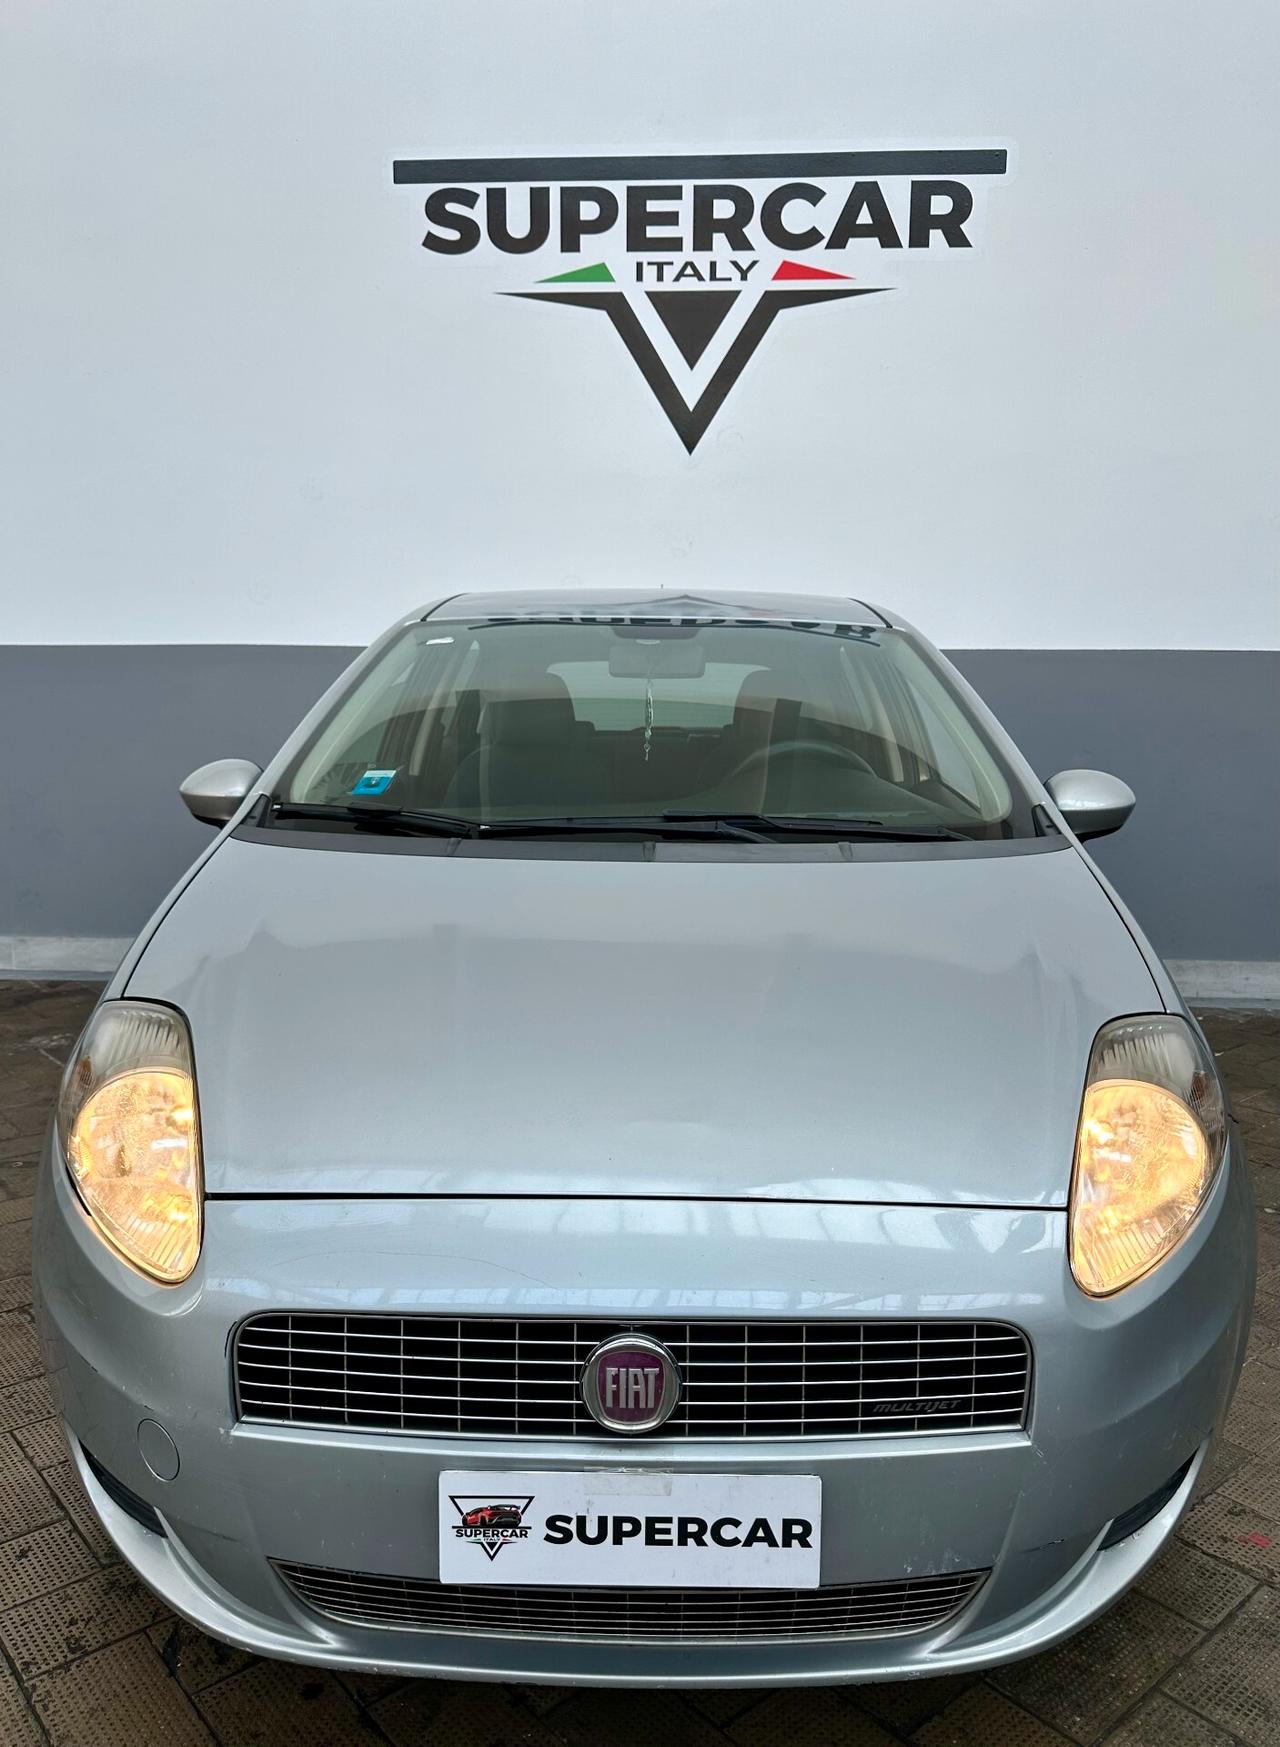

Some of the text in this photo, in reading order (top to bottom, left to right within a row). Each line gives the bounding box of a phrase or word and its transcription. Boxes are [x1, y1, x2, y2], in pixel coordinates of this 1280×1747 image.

[421, 180, 974, 255] SUPERCAR
[635, 260, 760, 283] ITALY
[605, 1367, 660, 1409] FIAT
[872, 1399, 963, 1414] MULTIJET
[455, 1529, 528, 1538] SUPERCAR
[544, 1515, 813, 1549] SUPERCAR
